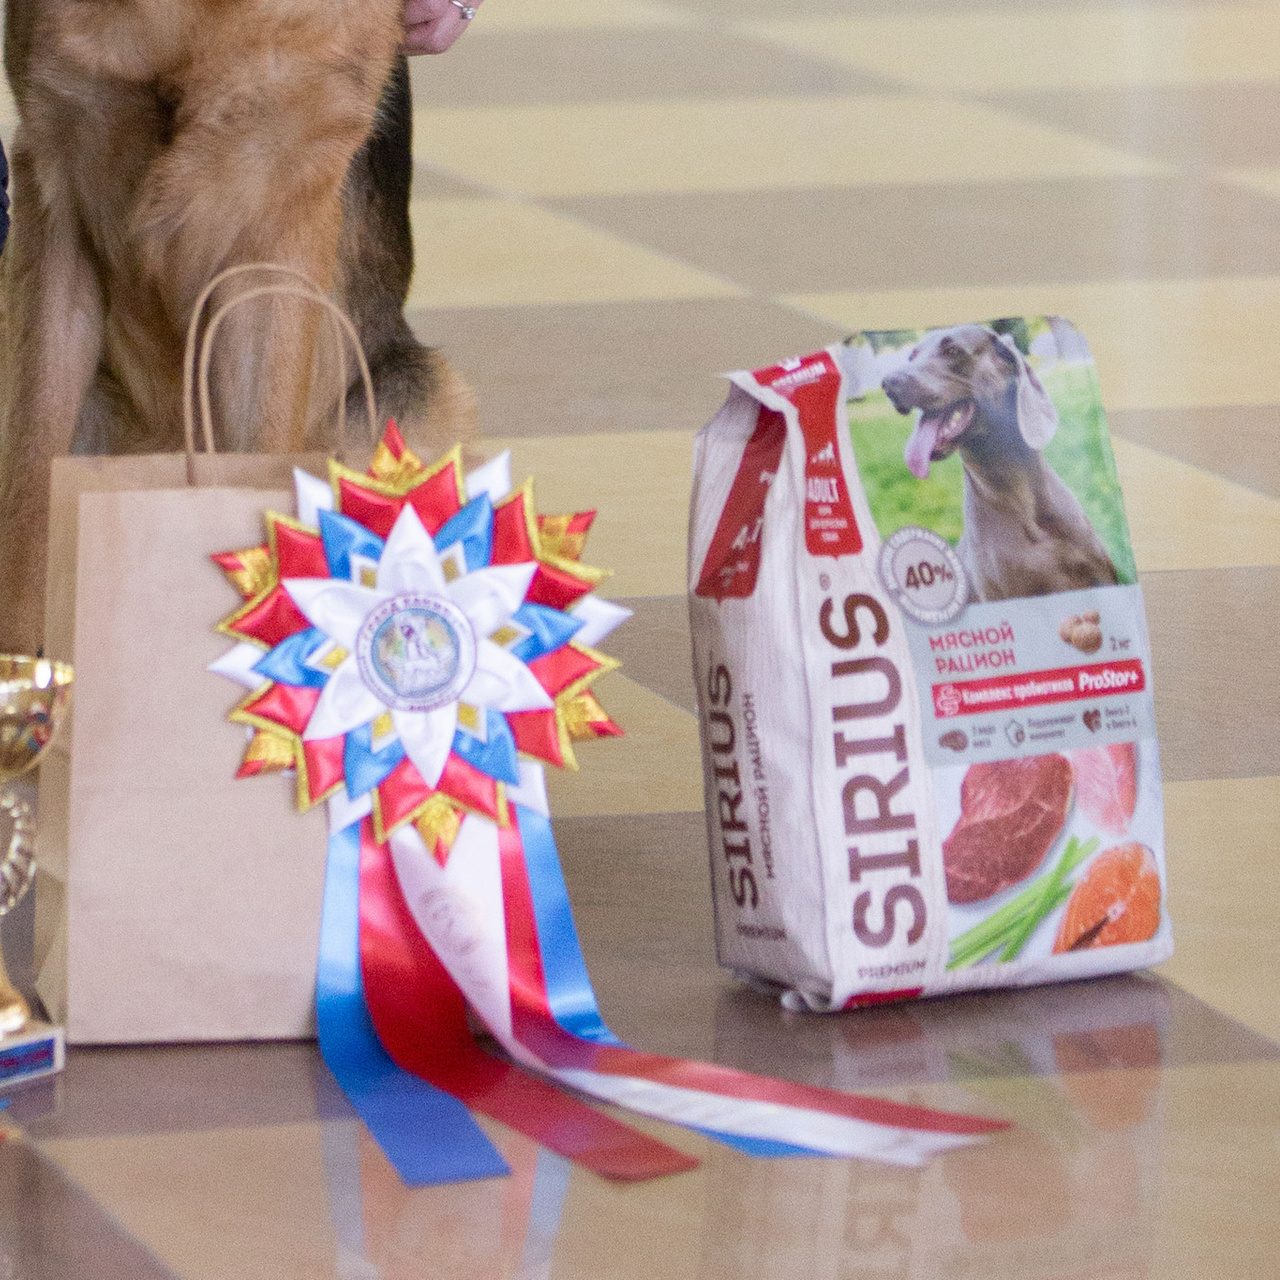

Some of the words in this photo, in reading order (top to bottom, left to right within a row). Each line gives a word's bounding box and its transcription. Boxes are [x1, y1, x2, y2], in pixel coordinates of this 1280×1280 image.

[905, 560, 954, 589] 40%
[928, 620, 1015, 652] МЯСНОЙ
[935, 648, 1016, 674] РАЦИОН
[1079, 668, 1139, 691] ProStor+
[742, 693, 768, 781] РАЦИОН
[707, 663, 759, 910] SIRIUS
[819, 593, 927, 948] SIRIUS
